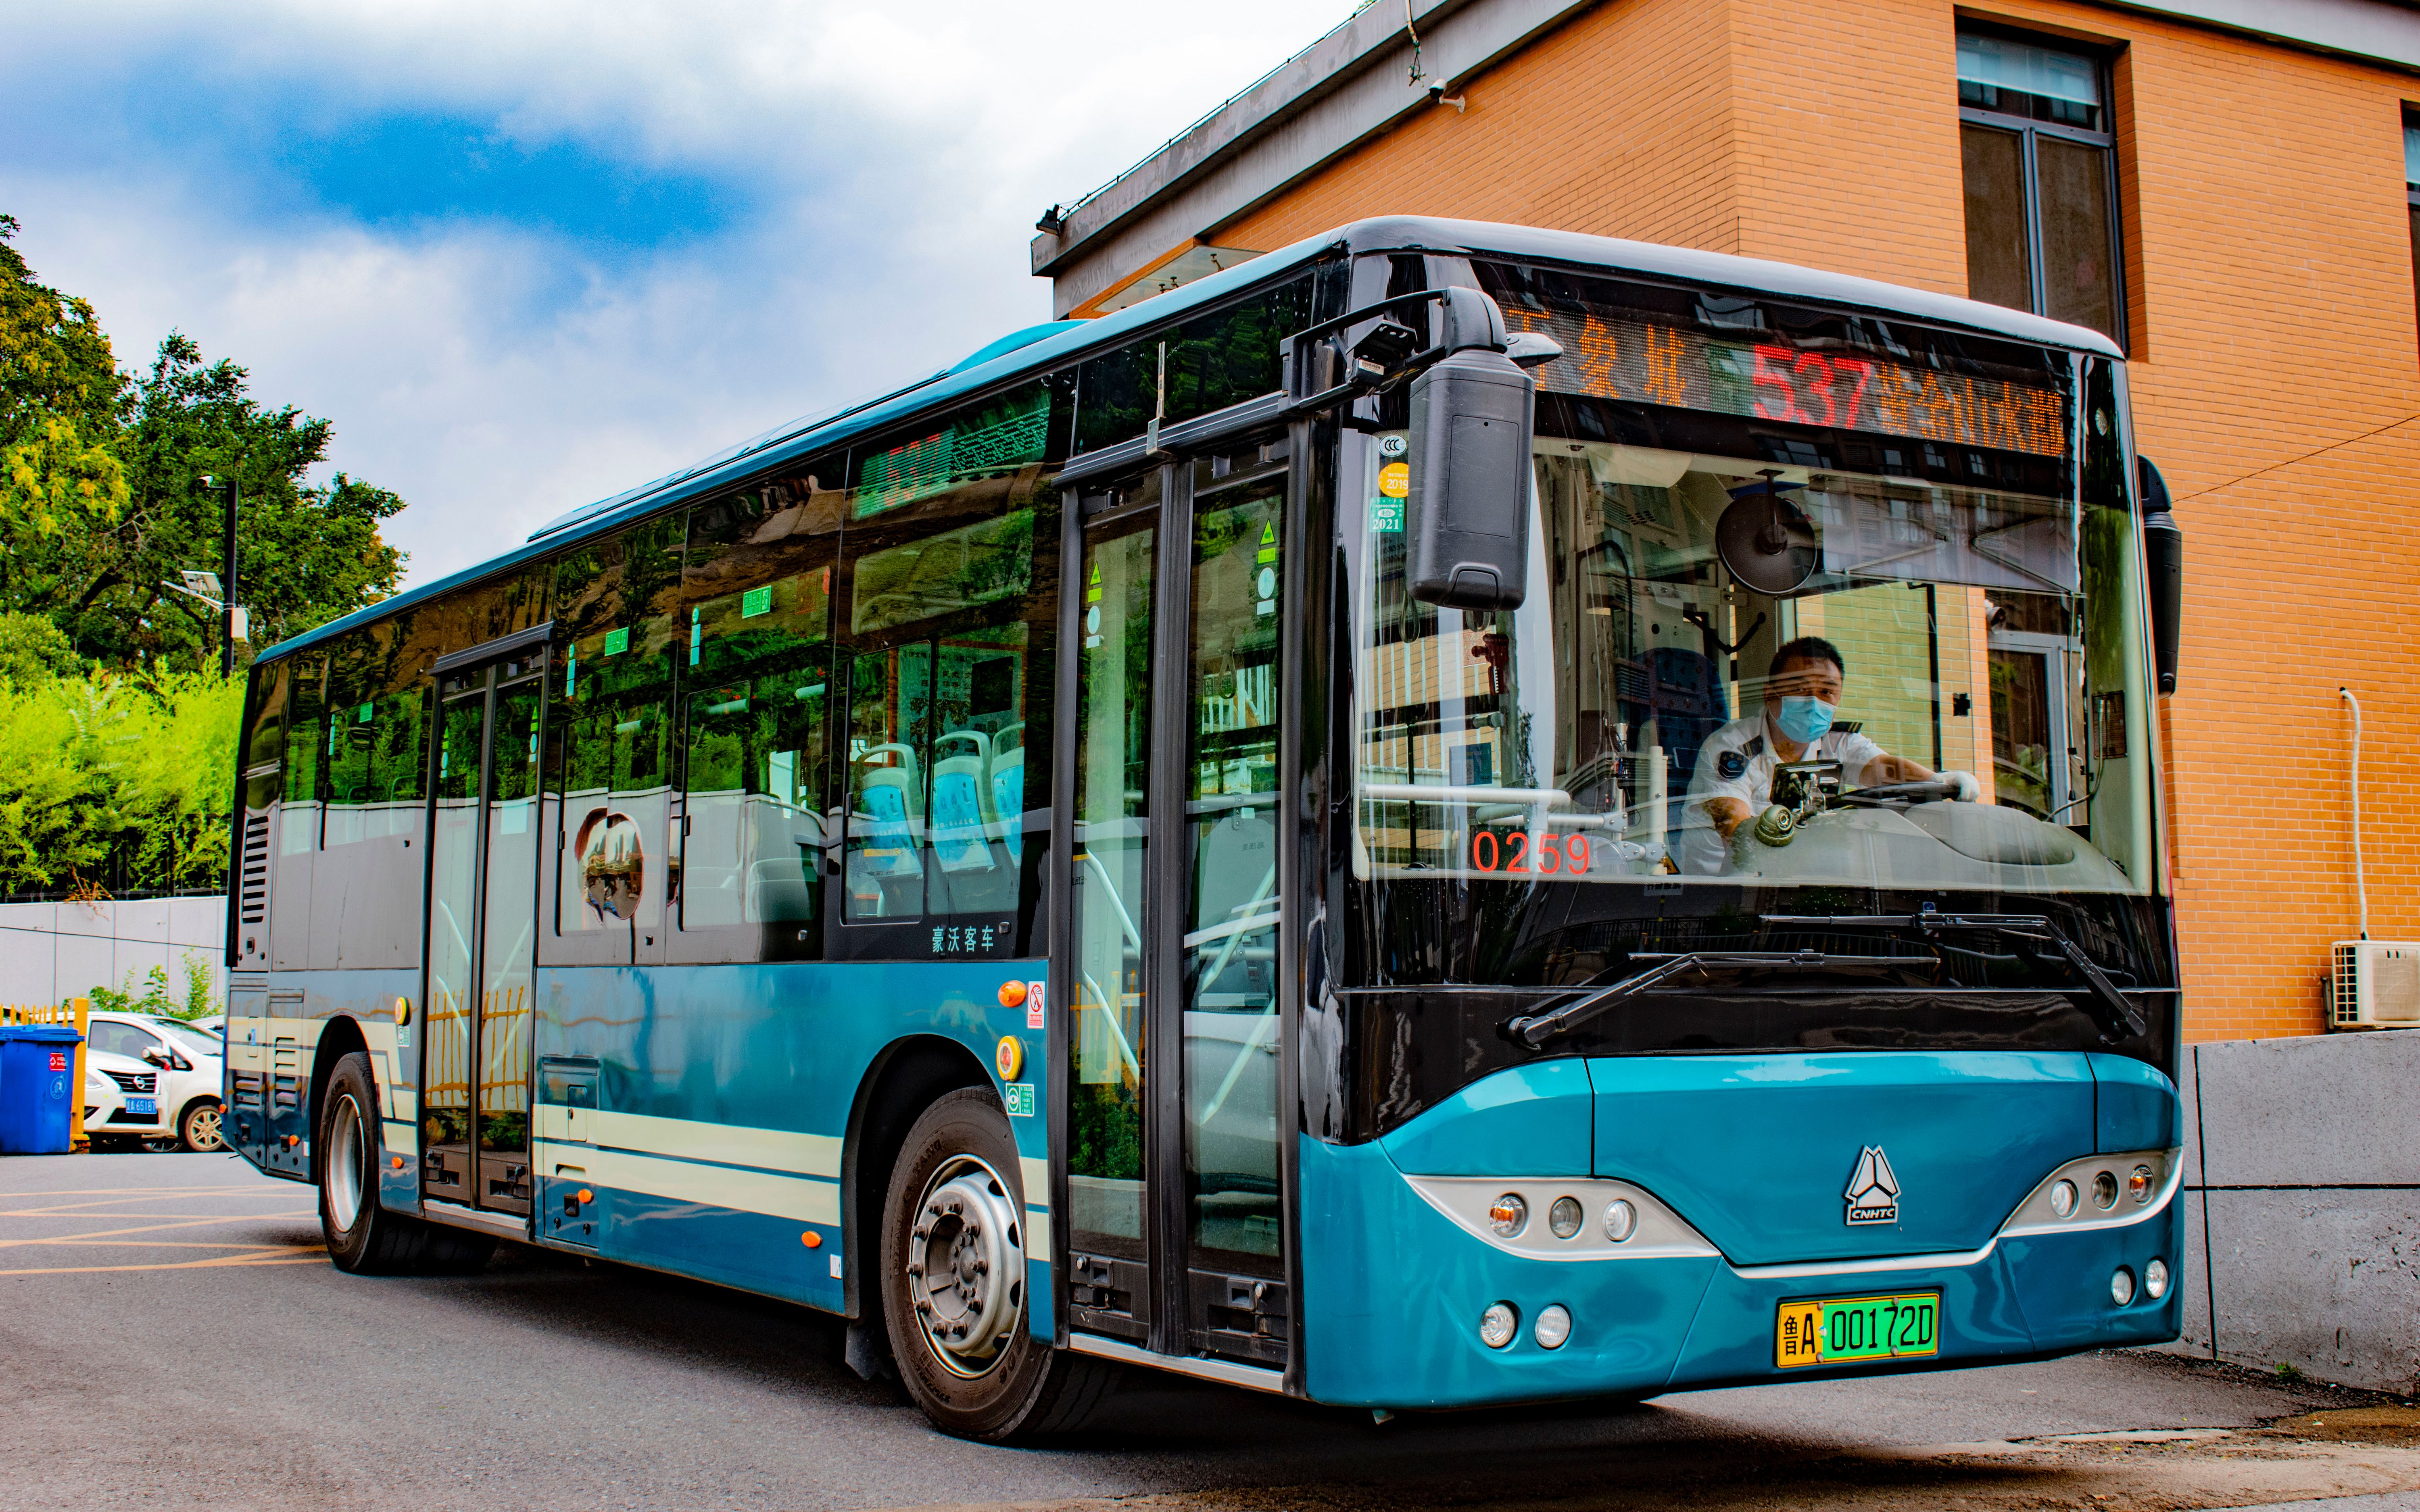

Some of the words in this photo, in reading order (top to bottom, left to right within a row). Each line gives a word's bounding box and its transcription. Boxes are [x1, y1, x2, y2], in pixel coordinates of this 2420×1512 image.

[1753, 345, 1871, 429] 537
[1386, 479, 1408, 490] 2019
[1373, 519, 1399, 529] 2021
[1473, 831, 1589, 875] 0259
[932, 925, 993, 953] 豪沃客车
[1851, 1208, 1894, 1219] CNHTC
